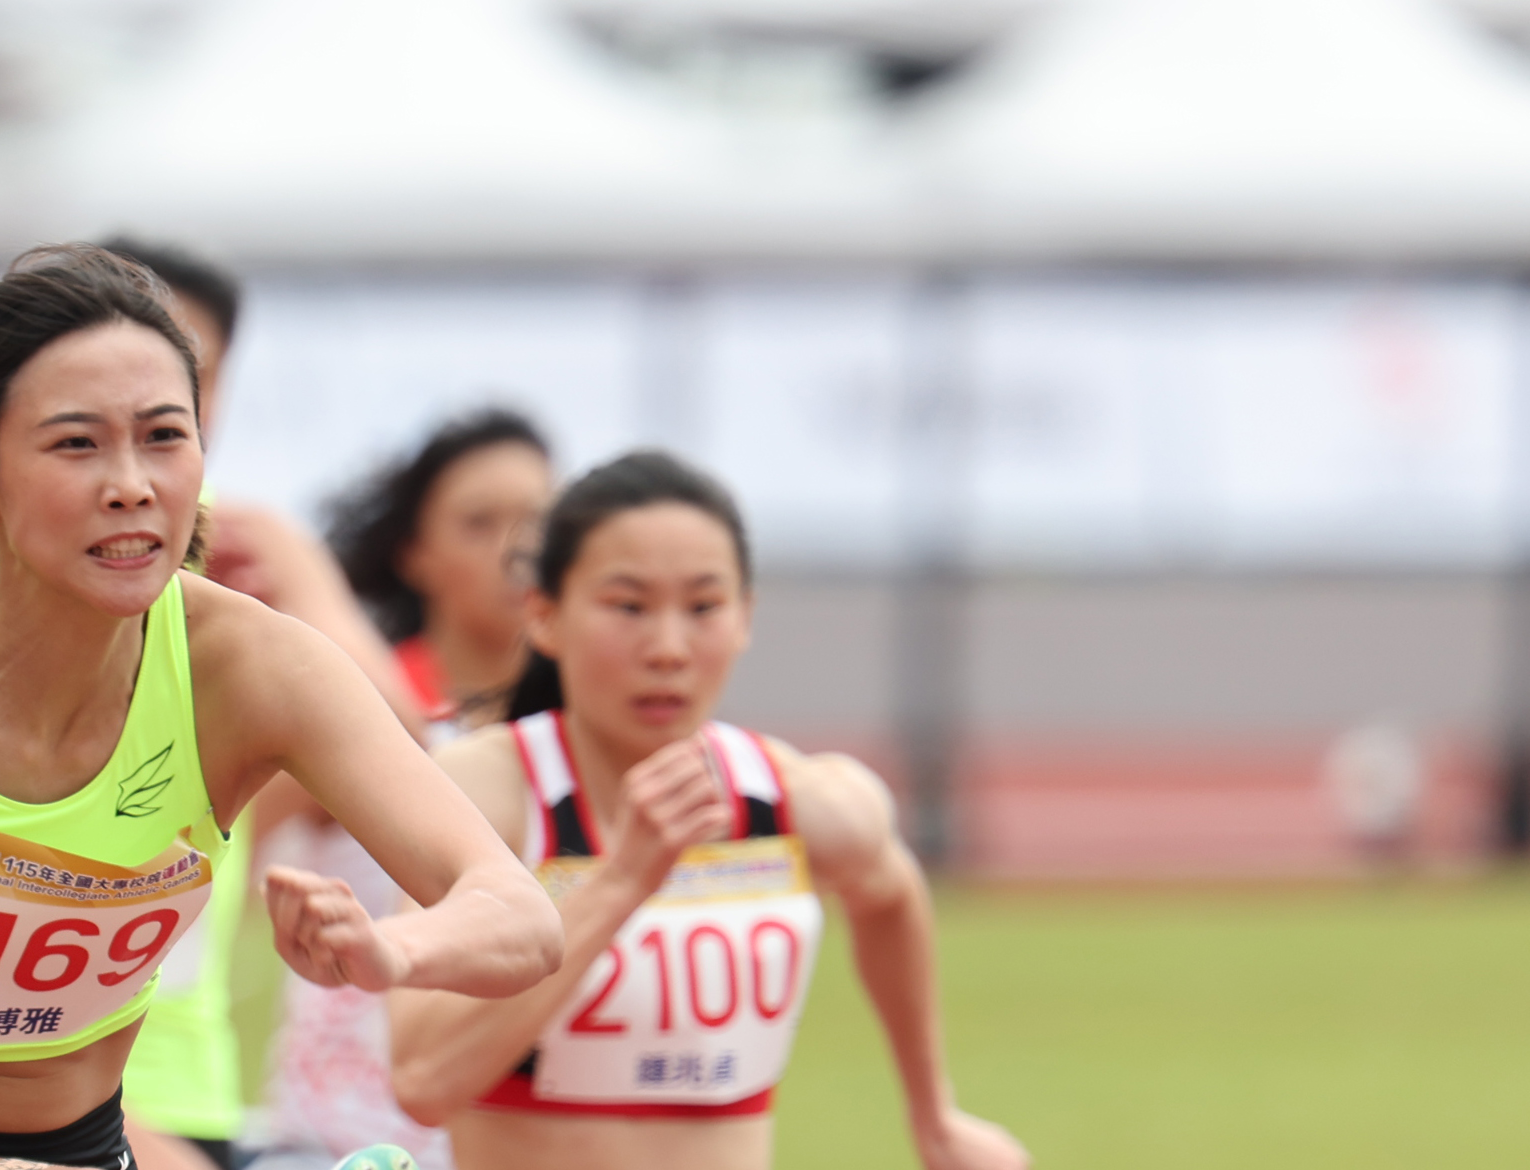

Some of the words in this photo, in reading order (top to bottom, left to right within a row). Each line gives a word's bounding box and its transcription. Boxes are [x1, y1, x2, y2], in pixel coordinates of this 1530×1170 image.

[17, 880, 111, 901] Intercollegiate
[113, 886, 161, 900] Athletic
[162, 869, 201, 890] Games
[566, 913, 802, 1036] 2100
